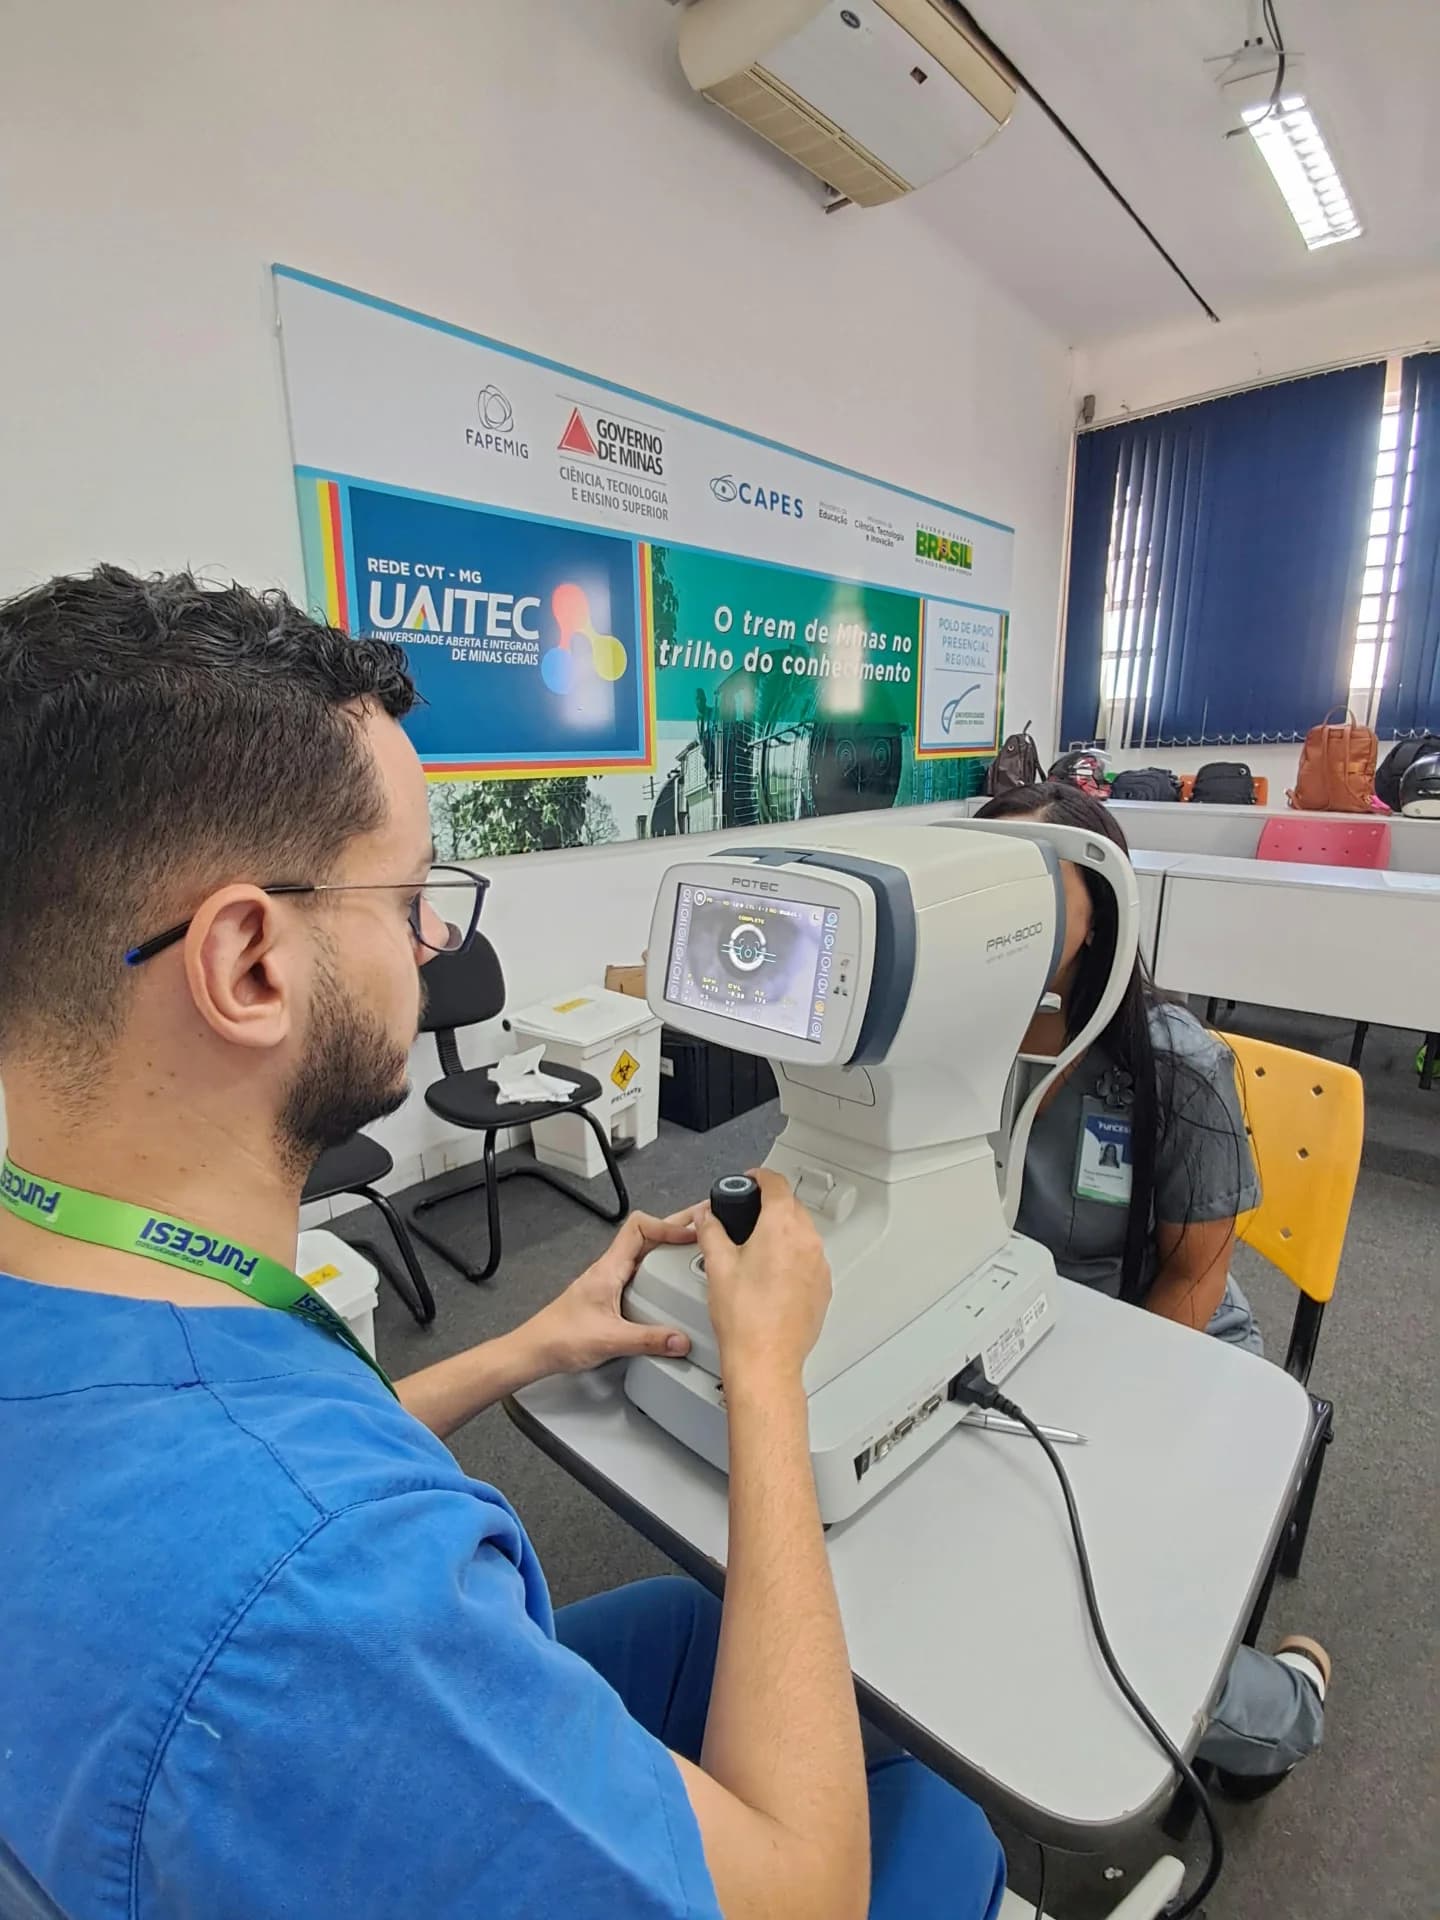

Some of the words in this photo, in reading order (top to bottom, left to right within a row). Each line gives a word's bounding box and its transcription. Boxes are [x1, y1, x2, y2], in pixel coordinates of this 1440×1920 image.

[466, 428, 528, 459] FAPEMIG
[597, 419, 663, 455] GOVERNO
[598, 440, 617, 463] DE
[619, 448, 663, 475] MINAS
[560, 466, 605, 490] CIÊNCIA,
[606, 478, 668, 505] TECNOLOGIA
[739, 482, 803, 519] CAPES
[572, 488, 578, 500] E
[581, 490, 619, 510] ENSINO
[622, 499, 668, 520] SUPERIOR
[916, 529, 972, 569] BRASIL
[367, 557, 410, 576] REDE
[414, 564, 445, 580] CVT
[459, 569, 482, 584] MG
[369, 580, 541, 640] UAITEC
[371, 630, 444, 646] UNIVERSIDADE
[445, 636, 481, 648] ABERTA
[483, 639, 488, 649] E
[489, 639, 540, 653] INTEGRADA
[714, 605, 734, 633] O
[743, 609, 796, 640] trem
[804, 618, 829, 645] de
[836, 622, 887, 650] Minas
[892, 634, 912, 653] no
[942, 636, 990, 653] PRESENCIAL
[452, 648, 467, 661] DE
[468, 650, 501, 663] MINAS
[504, 652, 538, 666] GERAIS
[658, 638, 734, 671] trilho
[744, 646, 774, 674] do
[945, 652, 986, 668] REGIONAL
[732, 877, 779, 892] POTEC
